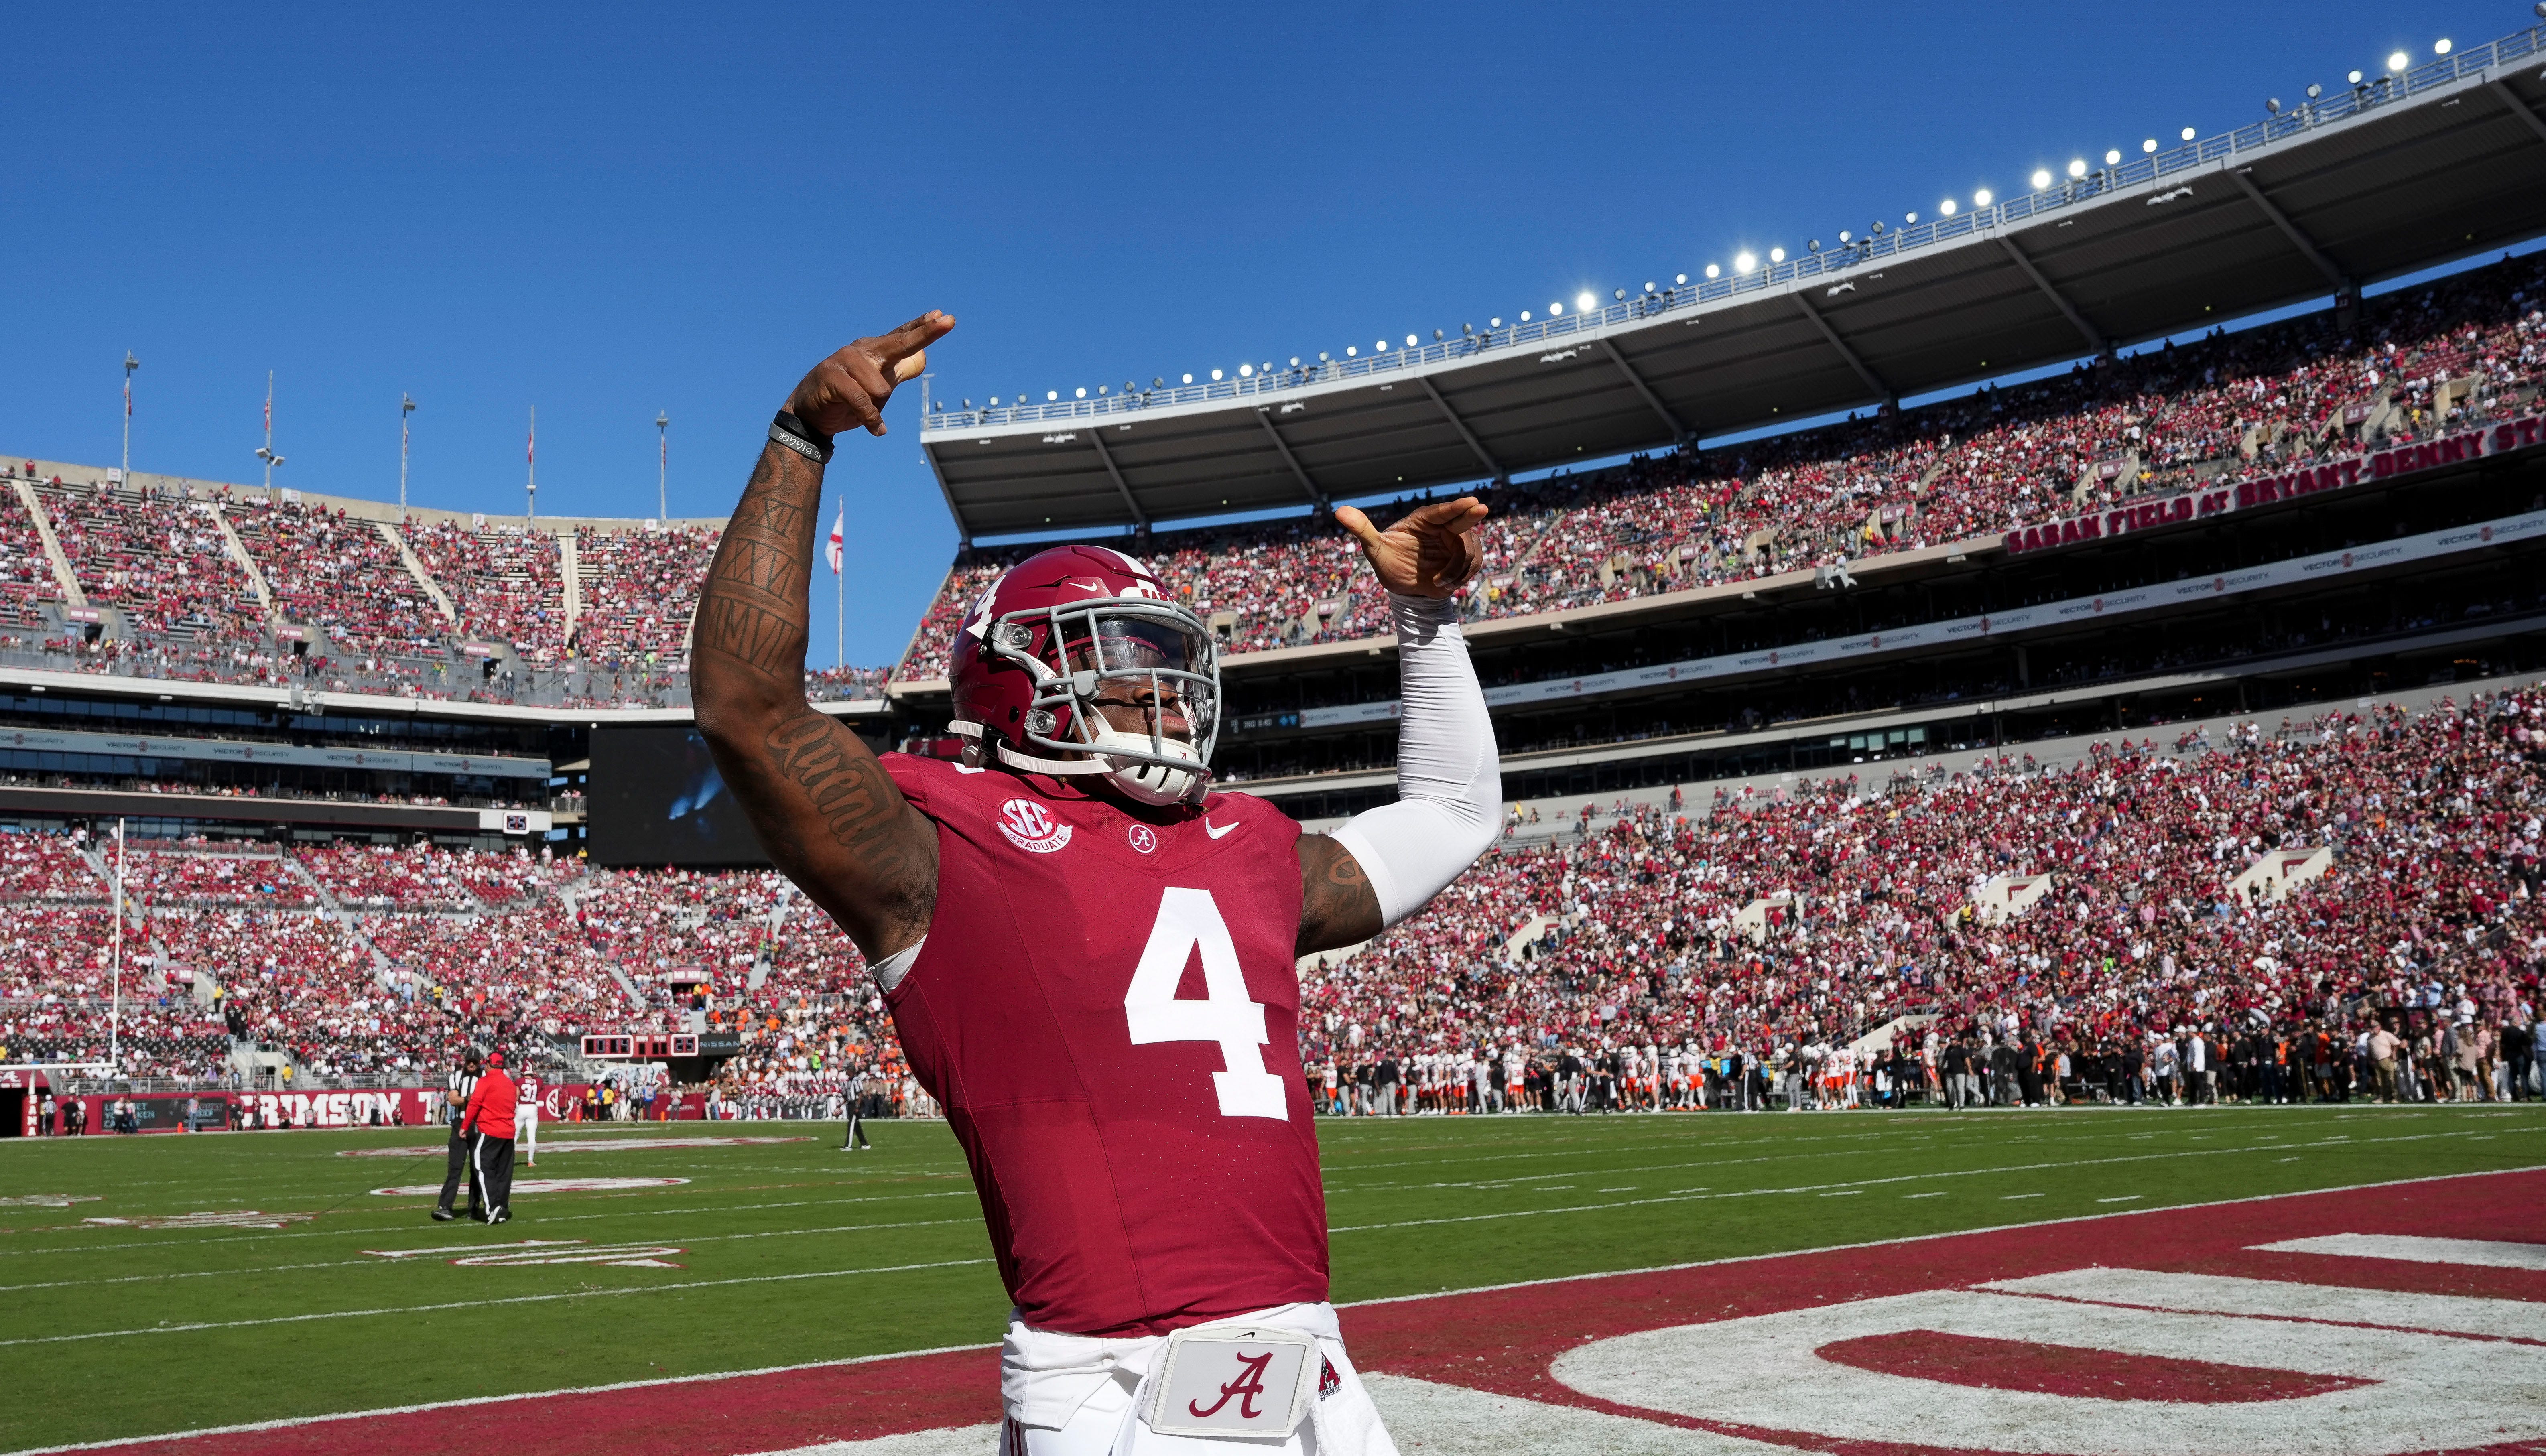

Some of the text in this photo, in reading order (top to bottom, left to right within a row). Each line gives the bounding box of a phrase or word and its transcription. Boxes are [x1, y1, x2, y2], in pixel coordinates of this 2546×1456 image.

[778, 431, 821, 459] IS BIGGER
[2008, 515, 2102, 553] SABAN
[2109, 496, 2194, 534] FIELD
[2201, 490, 2230, 513] AT
[2237, 430, 2485, 507] BRYANT-DENNY
[2437, 518, 2544, 545] VECTOR SECURITY
[717, 537, 800, 607] XXVI
[2303, 547, 2402, 571] VECTOR SECURITY
[2176, 572, 2269, 594] VECTOR SECURITY
[965, 574, 1008, 640] 4
[2059, 594, 2147, 614] VECTOR SECURITY
[1947, 614, 2031, 633] VECTOR SECURITY
[1840, 633, 1920, 650] VECTOR SECURITY
[766, 714, 910, 881] Quentin
[508, 816, 526, 830] 25
[1003, 799, 1053, 837] SEC
[1009, 833, 1067, 851] GRADUATE
[1133, 828, 1151, 847] A
[1124, 886, 1290, 1122] 4
[520, 1083, 538, 1102] 31
[240, 1092, 401, 1127] CRIMSON
[1189, 1350, 1274, 1419] A
